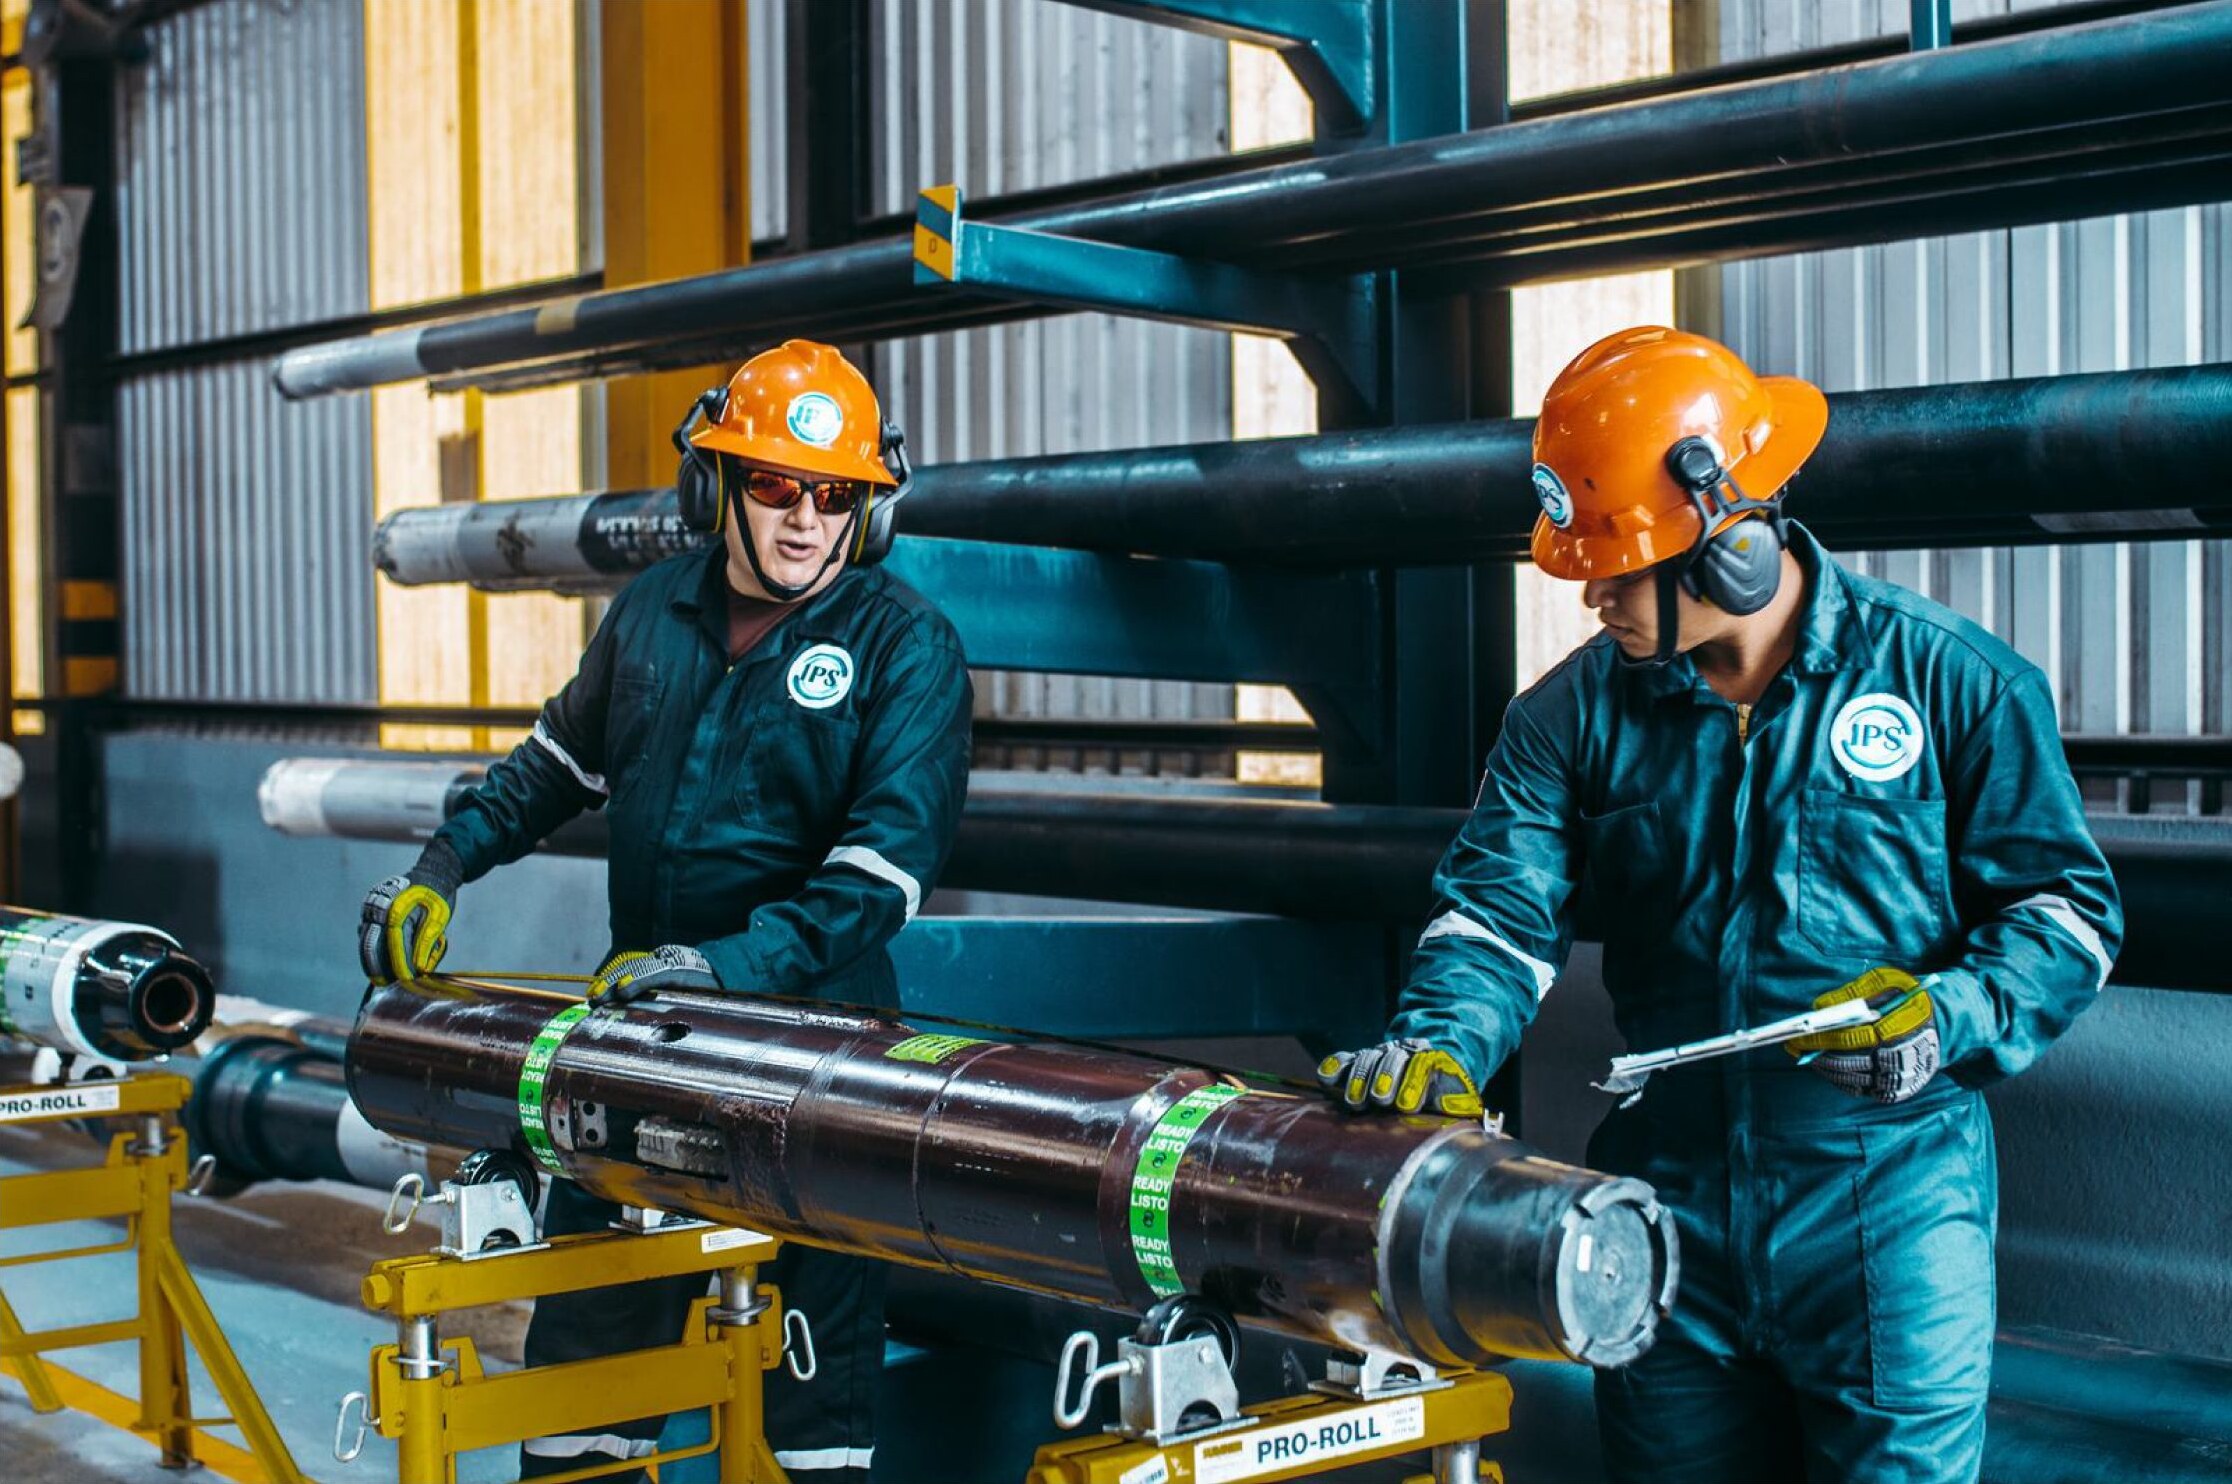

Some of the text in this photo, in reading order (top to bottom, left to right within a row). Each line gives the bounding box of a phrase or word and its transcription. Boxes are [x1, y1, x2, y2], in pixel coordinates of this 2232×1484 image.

[1850, 723, 1902, 751] IPS
[1154, 1123, 1194, 1138] READY
[1147, 1137, 1184, 1153] LISTO
[1133, 1175, 1169, 1193] READY
[1131, 1193, 1168, 1210] LISTO
[1132, 1235, 1169, 1252] READY
[1136, 1250, 1173, 1267] LISTO
[1257, 1416, 1381, 1464] PRO-ROLL
